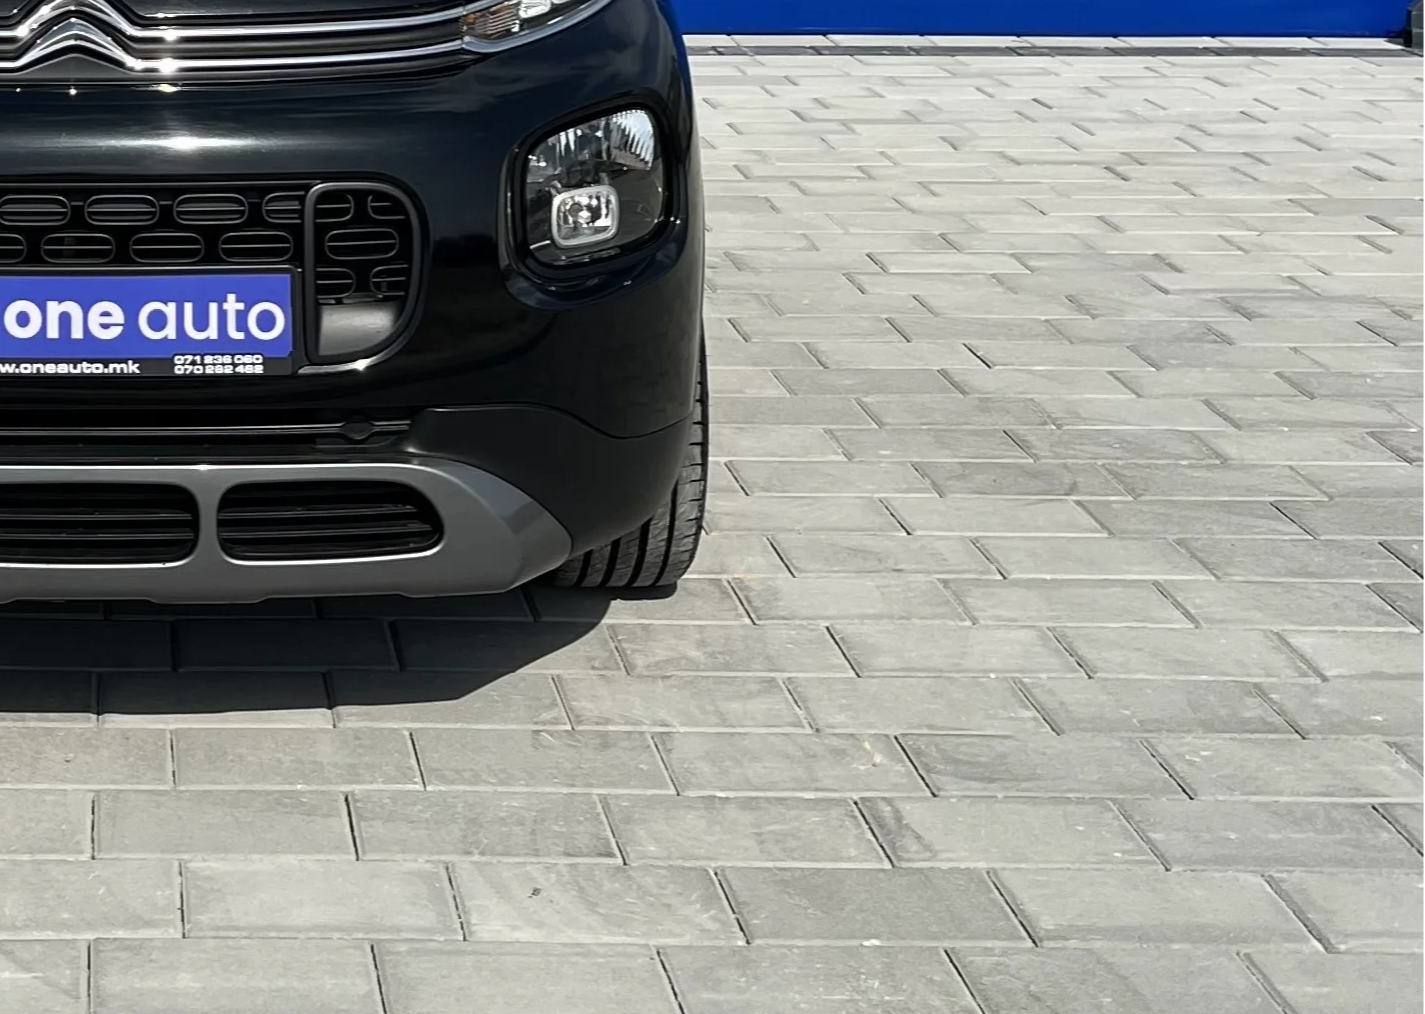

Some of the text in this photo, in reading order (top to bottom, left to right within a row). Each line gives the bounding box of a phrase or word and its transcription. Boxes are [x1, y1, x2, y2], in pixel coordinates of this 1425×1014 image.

[3, 293, 286, 341] one auto
[174, 355, 201, 364] 071
[174, 365, 204, 374] 070
